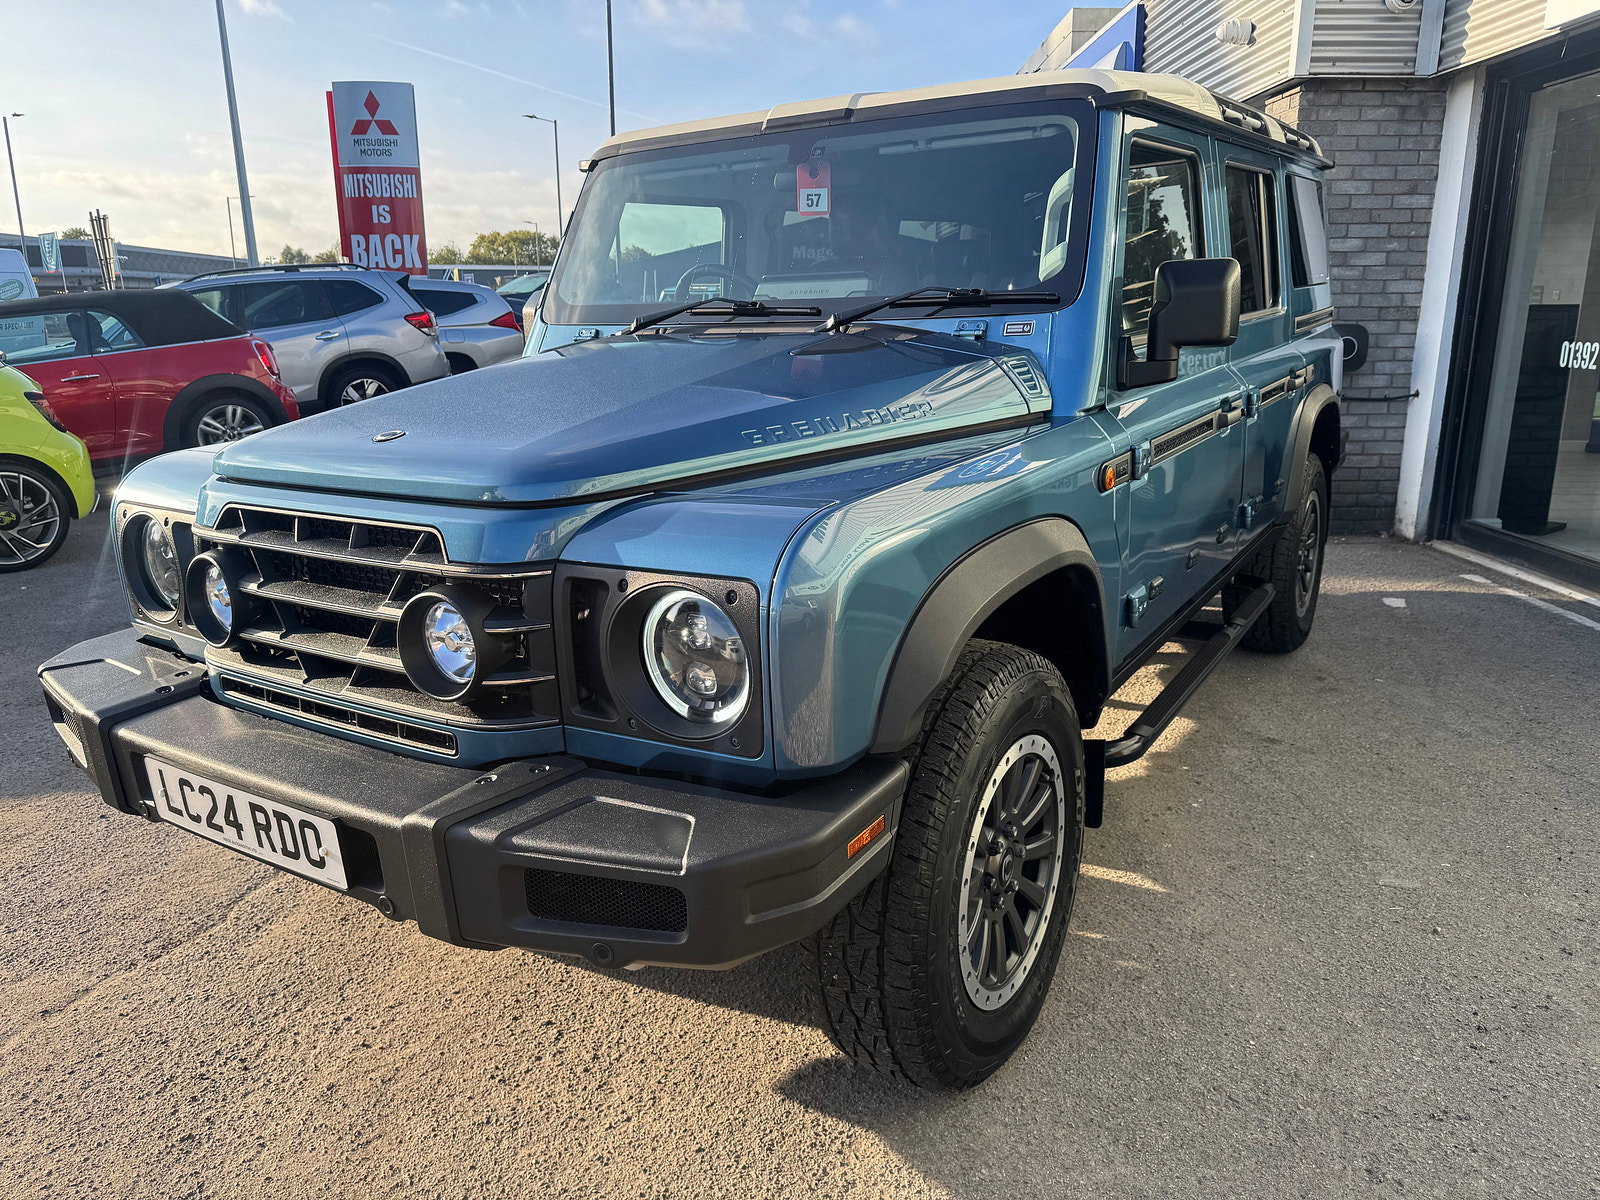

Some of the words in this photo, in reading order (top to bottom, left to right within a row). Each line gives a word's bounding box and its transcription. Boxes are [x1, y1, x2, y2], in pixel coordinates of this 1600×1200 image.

[353, 138, 399, 148] MITSUBISHI
[360, 149, 393, 158] MOTORS
[343, 173, 418, 199] MITSUBISHI
[806, 193, 822, 208] 57
[371, 204, 391, 224] IS
[350, 233, 423, 270] BACK
[4, 321, 34, 331] SPECIALIST
[1560, 340, 1600, 370] 01392
[741, 399, 936, 447] GRENADIER
[157, 768, 244, 841] LC24
[248, 801, 327, 870] RDO
